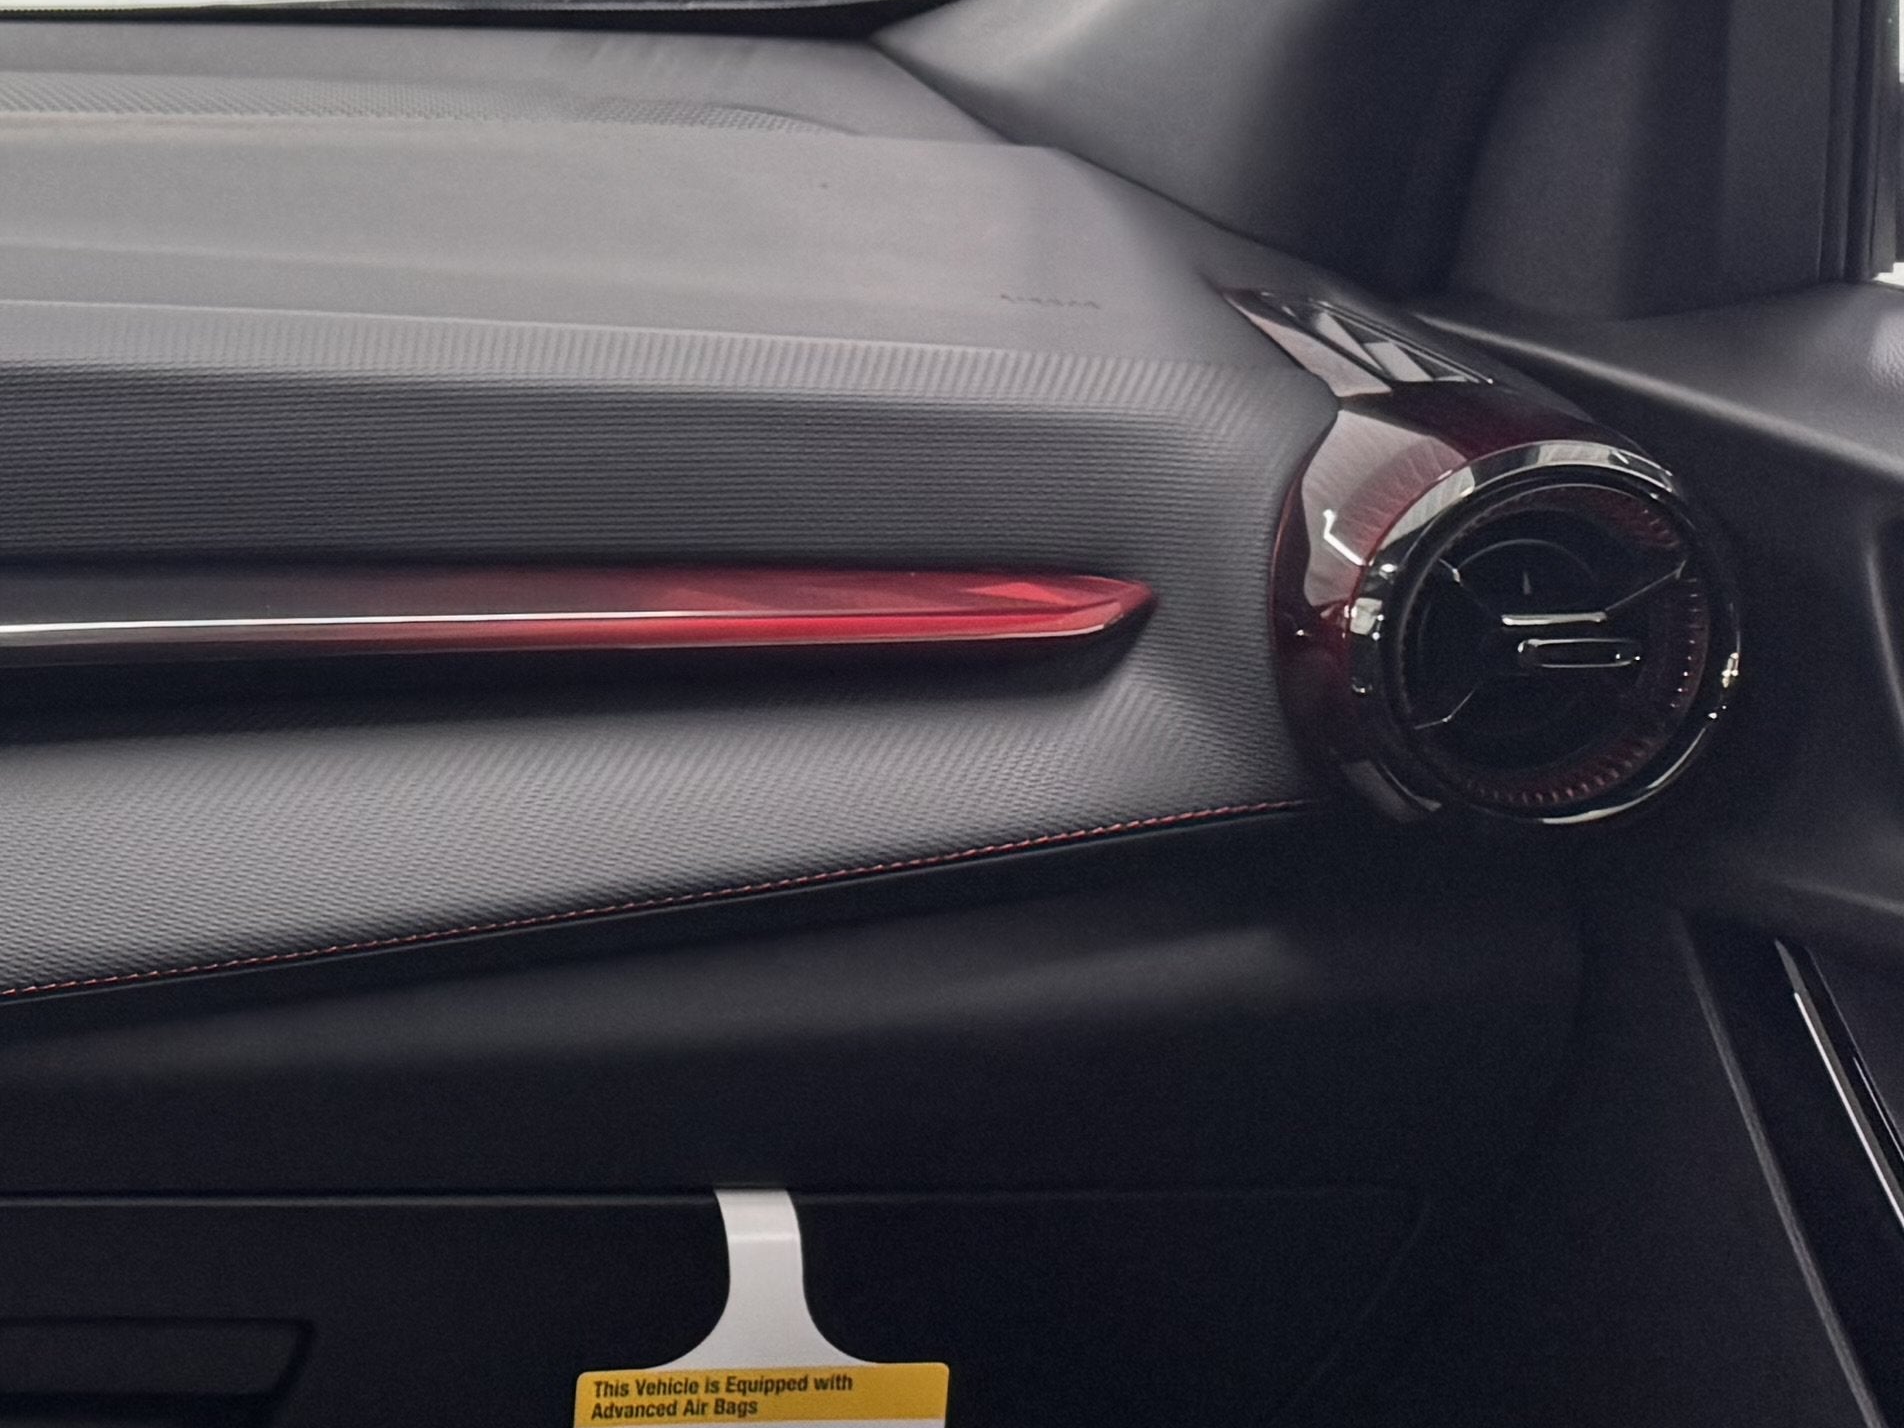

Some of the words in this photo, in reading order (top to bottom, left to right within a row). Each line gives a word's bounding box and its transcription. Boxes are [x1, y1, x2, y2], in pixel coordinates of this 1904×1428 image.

[594, 1380, 630, 1398] This
[635, 1377, 699, 1397] Vehicle
[704, 1378, 720, 1393] is
[725, 1375, 808, 1396] Equipped
[814, 1374, 853, 1392] with
[591, 1400, 678, 1420] Advanced
[683, 1399, 707, 1417] Air
[713, 1399, 758, 1418] Bags
